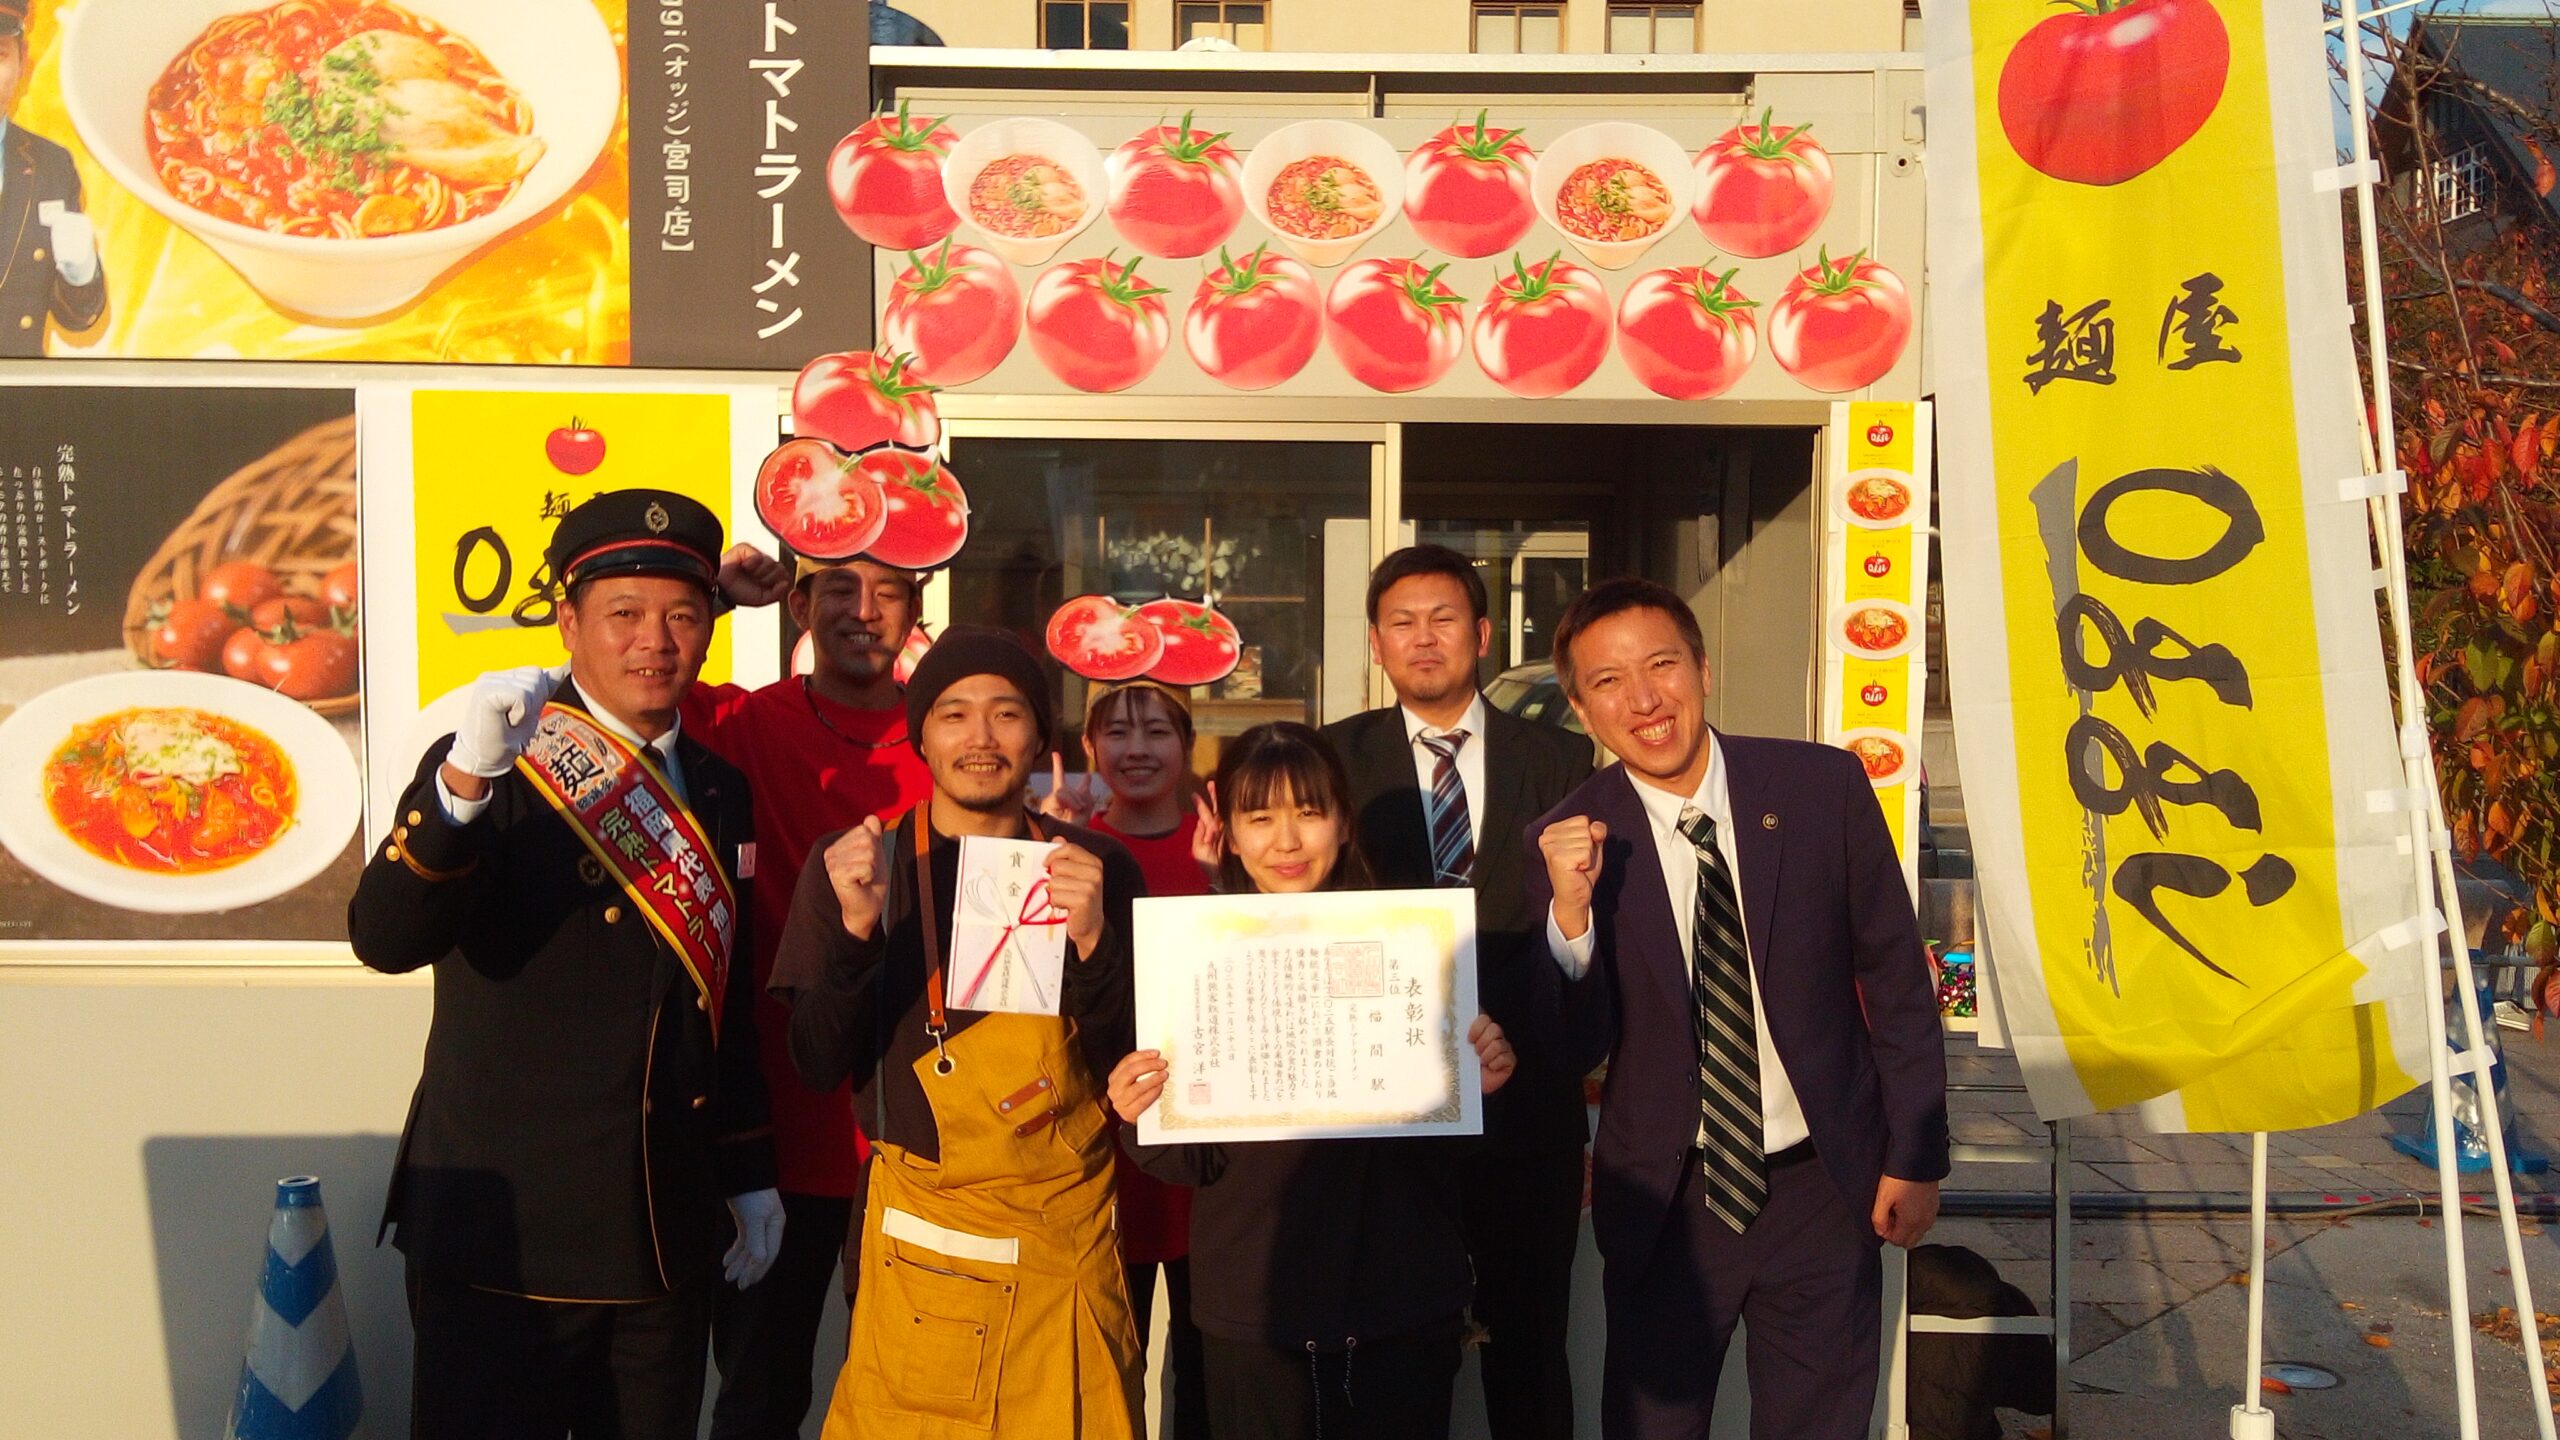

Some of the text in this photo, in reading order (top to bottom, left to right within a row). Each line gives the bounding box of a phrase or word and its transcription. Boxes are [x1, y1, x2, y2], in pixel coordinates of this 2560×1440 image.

[748, 2, 805, 339] トマトラーメン
[2022, 272, 2243, 396] 麺屋
[56, 444, 80, 616] 完熟トマトラーメン
[539, 490, 604, 521] 麺
[2056, 465, 2297, 987] Oggi
[598, 805, 728, 984] 完熟トマトラーメ
[1404, 977, 1426, 1048] 表彰状
